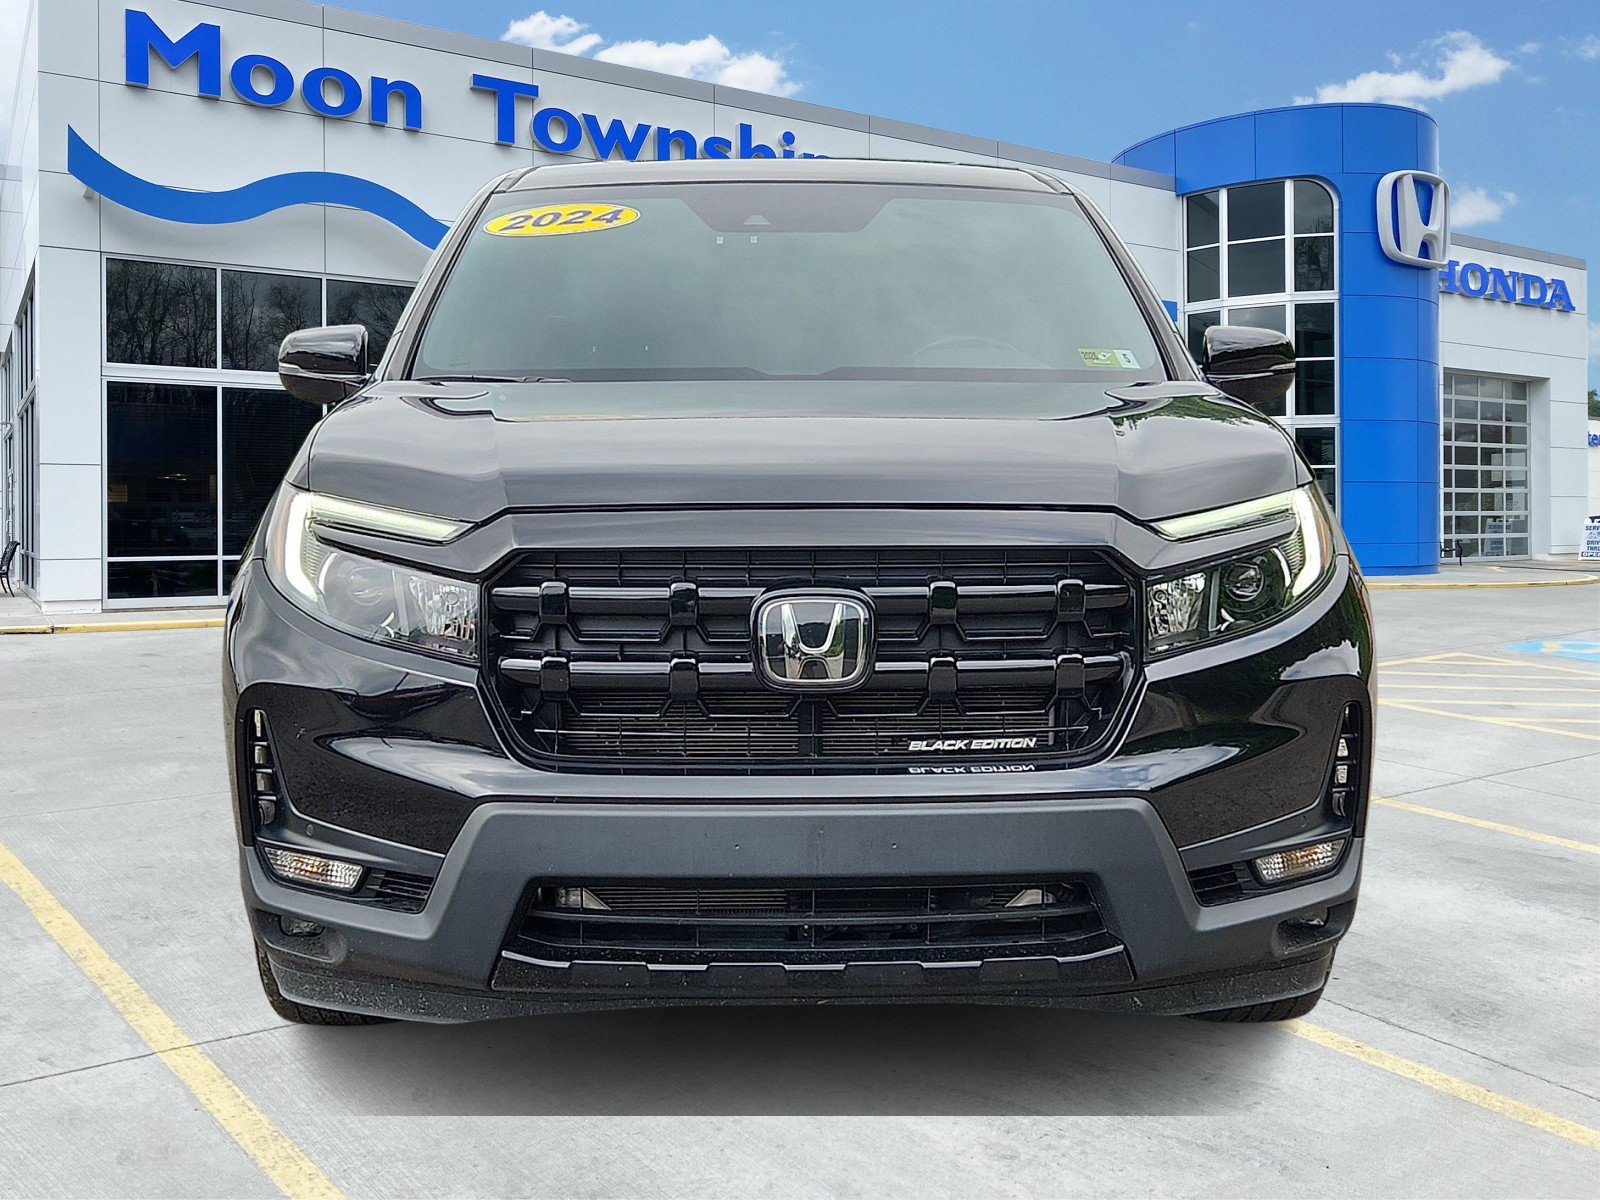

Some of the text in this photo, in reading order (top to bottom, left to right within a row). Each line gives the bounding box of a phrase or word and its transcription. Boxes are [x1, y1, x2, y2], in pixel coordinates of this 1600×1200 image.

[124, 8, 832, 160] Moon Townsh
[498, 209, 624, 231] 2024
[908, 737, 1037, 751] BLACK EDITION
